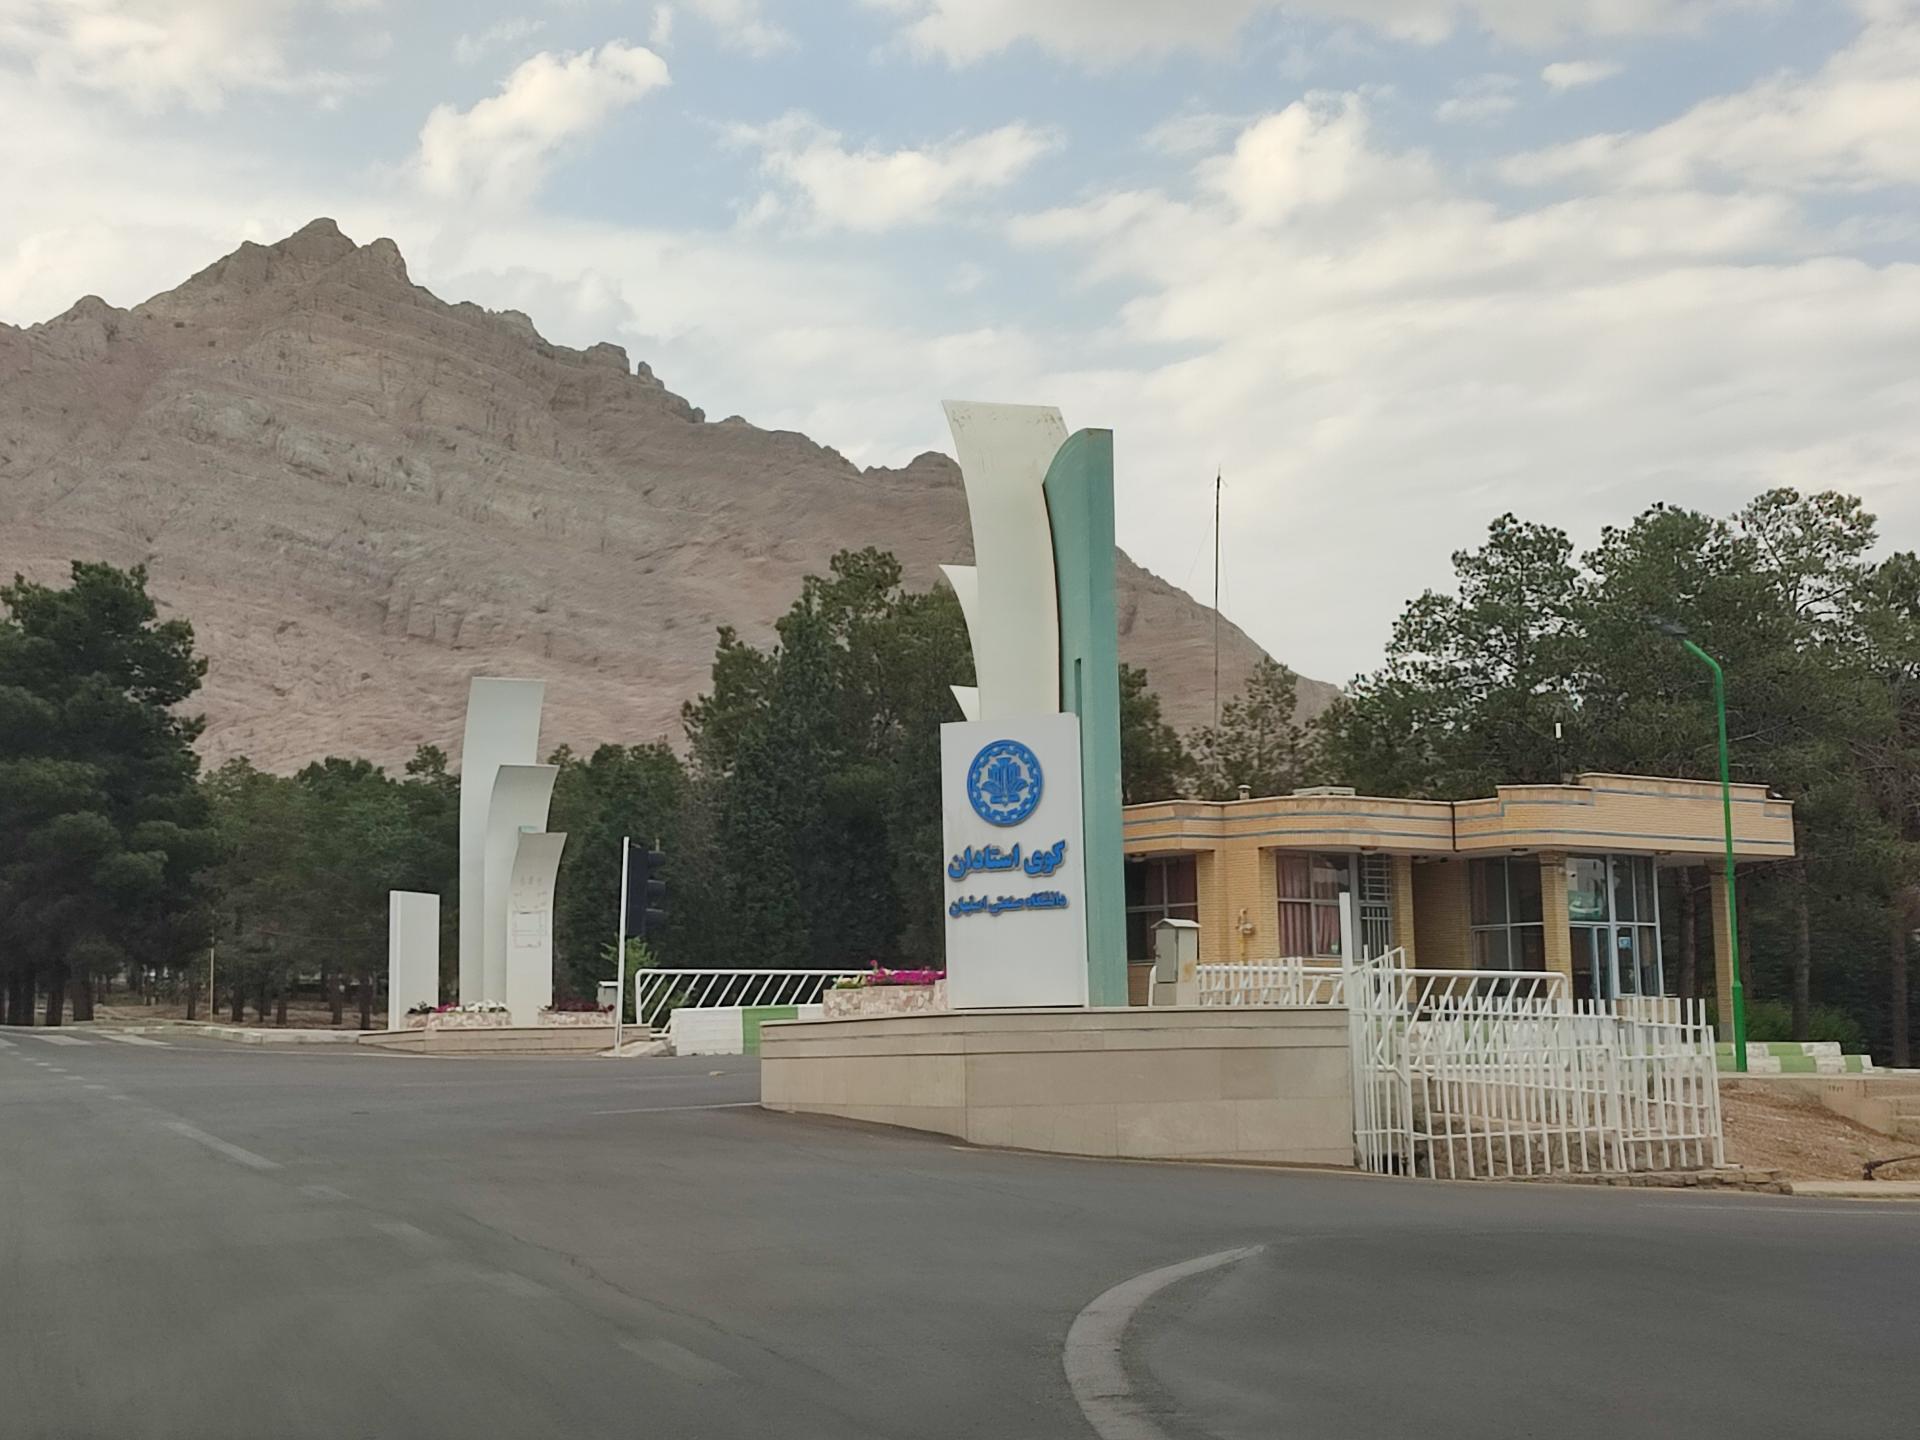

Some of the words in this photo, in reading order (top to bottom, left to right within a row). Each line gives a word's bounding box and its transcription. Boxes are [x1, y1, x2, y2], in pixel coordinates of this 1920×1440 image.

[948, 842, 1021, 880] استادان
[1024, 839, 1066, 876] کوی
[949, 894, 988, 918] اصفهان
[988, 895, 1025, 916] صنعتی
[1025, 890, 1068, 909] دانشگاه
